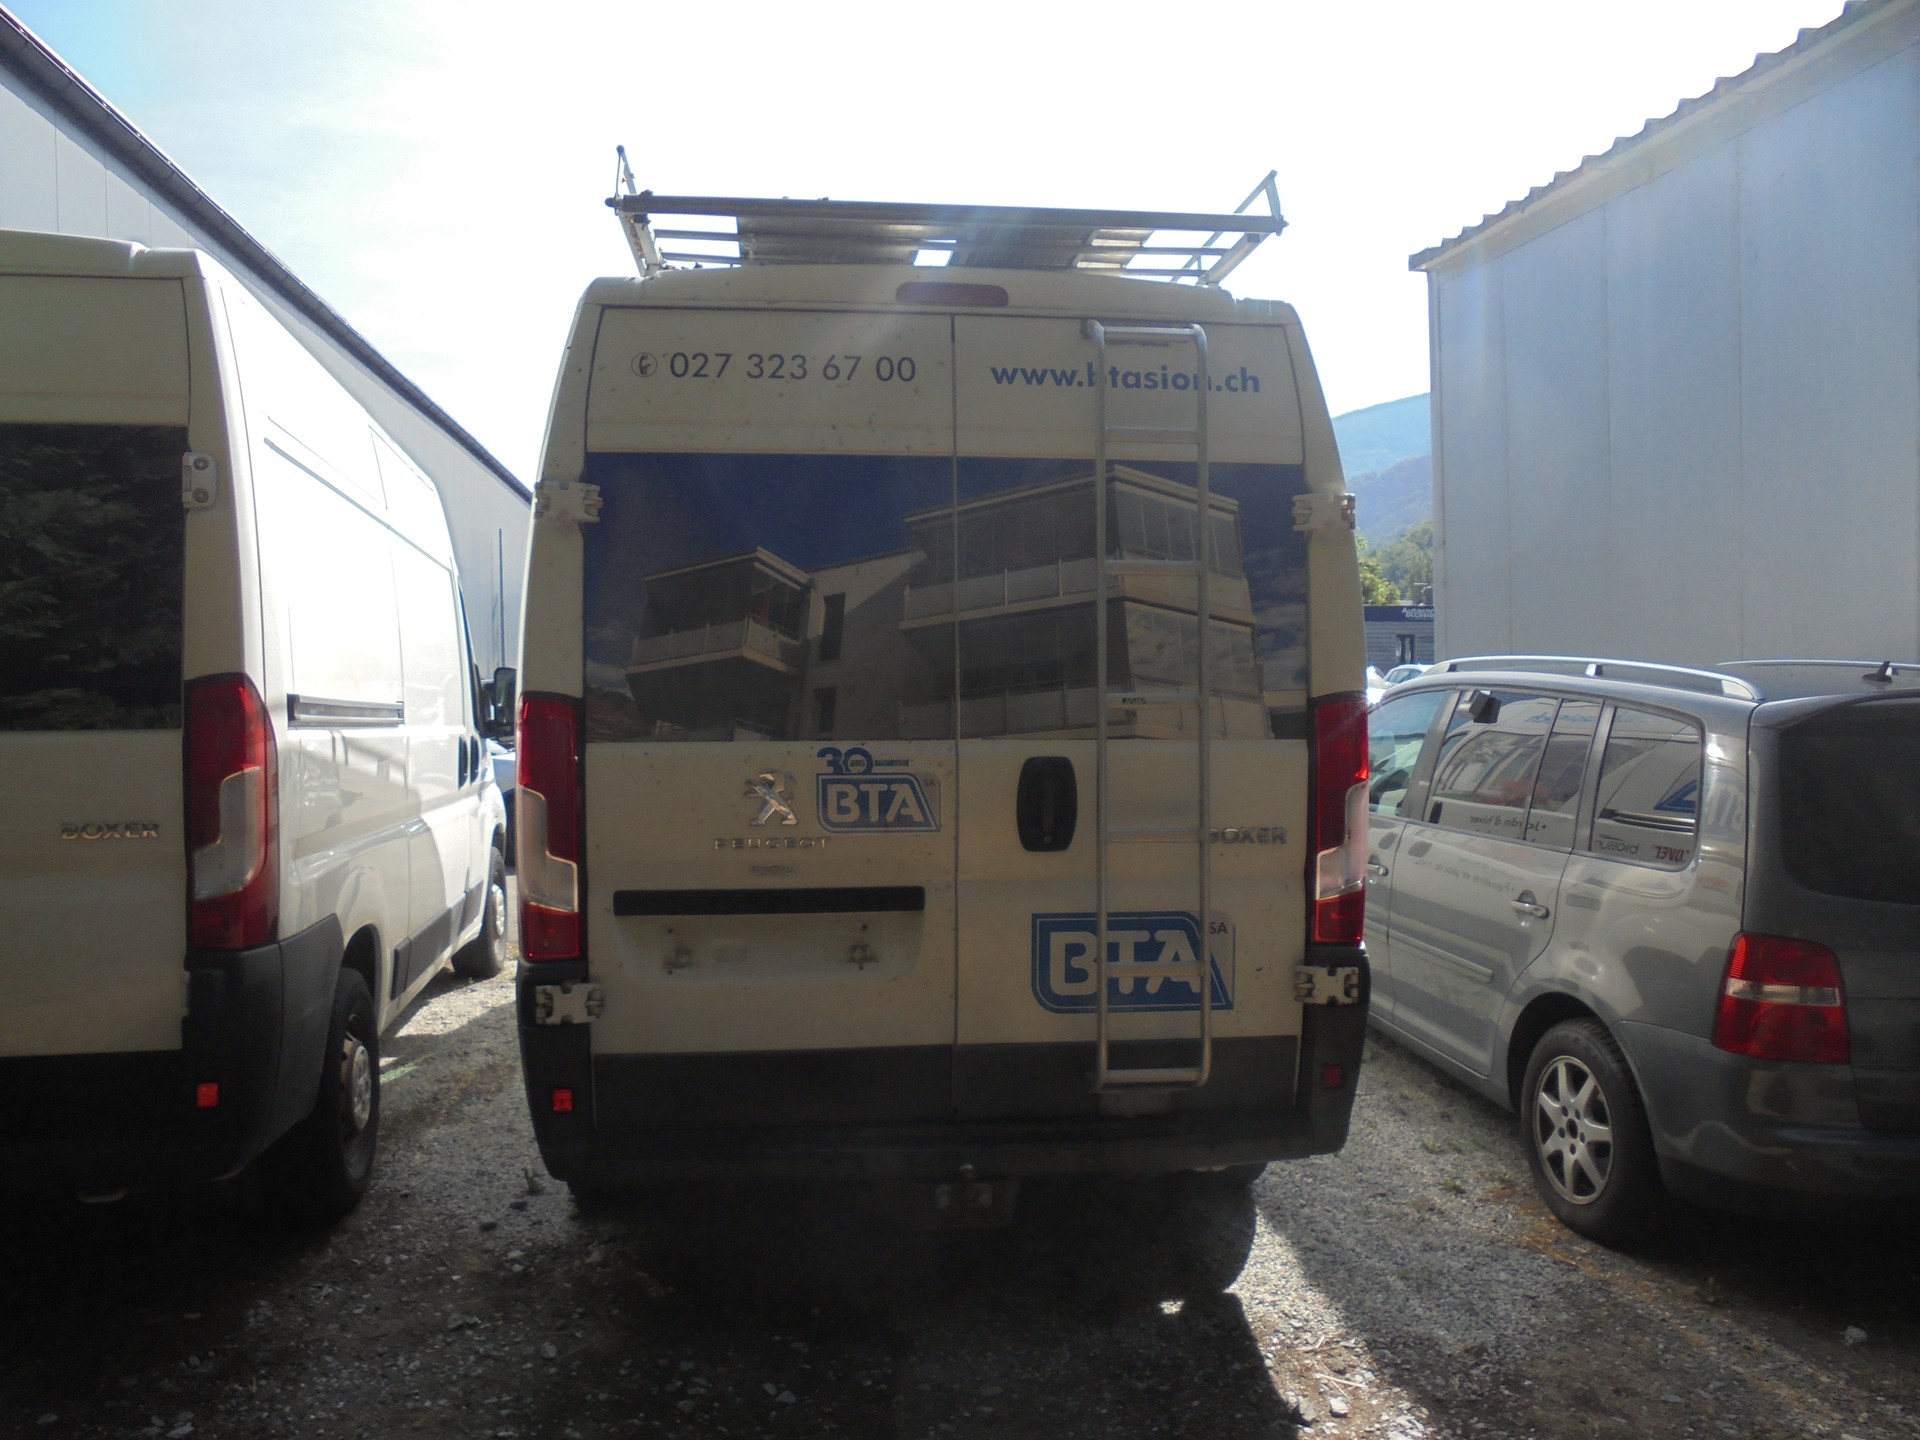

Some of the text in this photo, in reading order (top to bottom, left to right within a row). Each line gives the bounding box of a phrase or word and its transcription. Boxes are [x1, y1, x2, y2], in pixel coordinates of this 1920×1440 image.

[670, 351, 917, 383] 027 323 67 00
[817, 747, 873, 774] 30
[850, 758, 866, 768] ans
[827, 783, 924, 823] BTA
[61, 821, 159, 840] BOXER
[713, 836, 830, 849] PEUGEOT
[1209, 921, 1228, 934] SA
[1050, 929, 1203, 995] BTA
